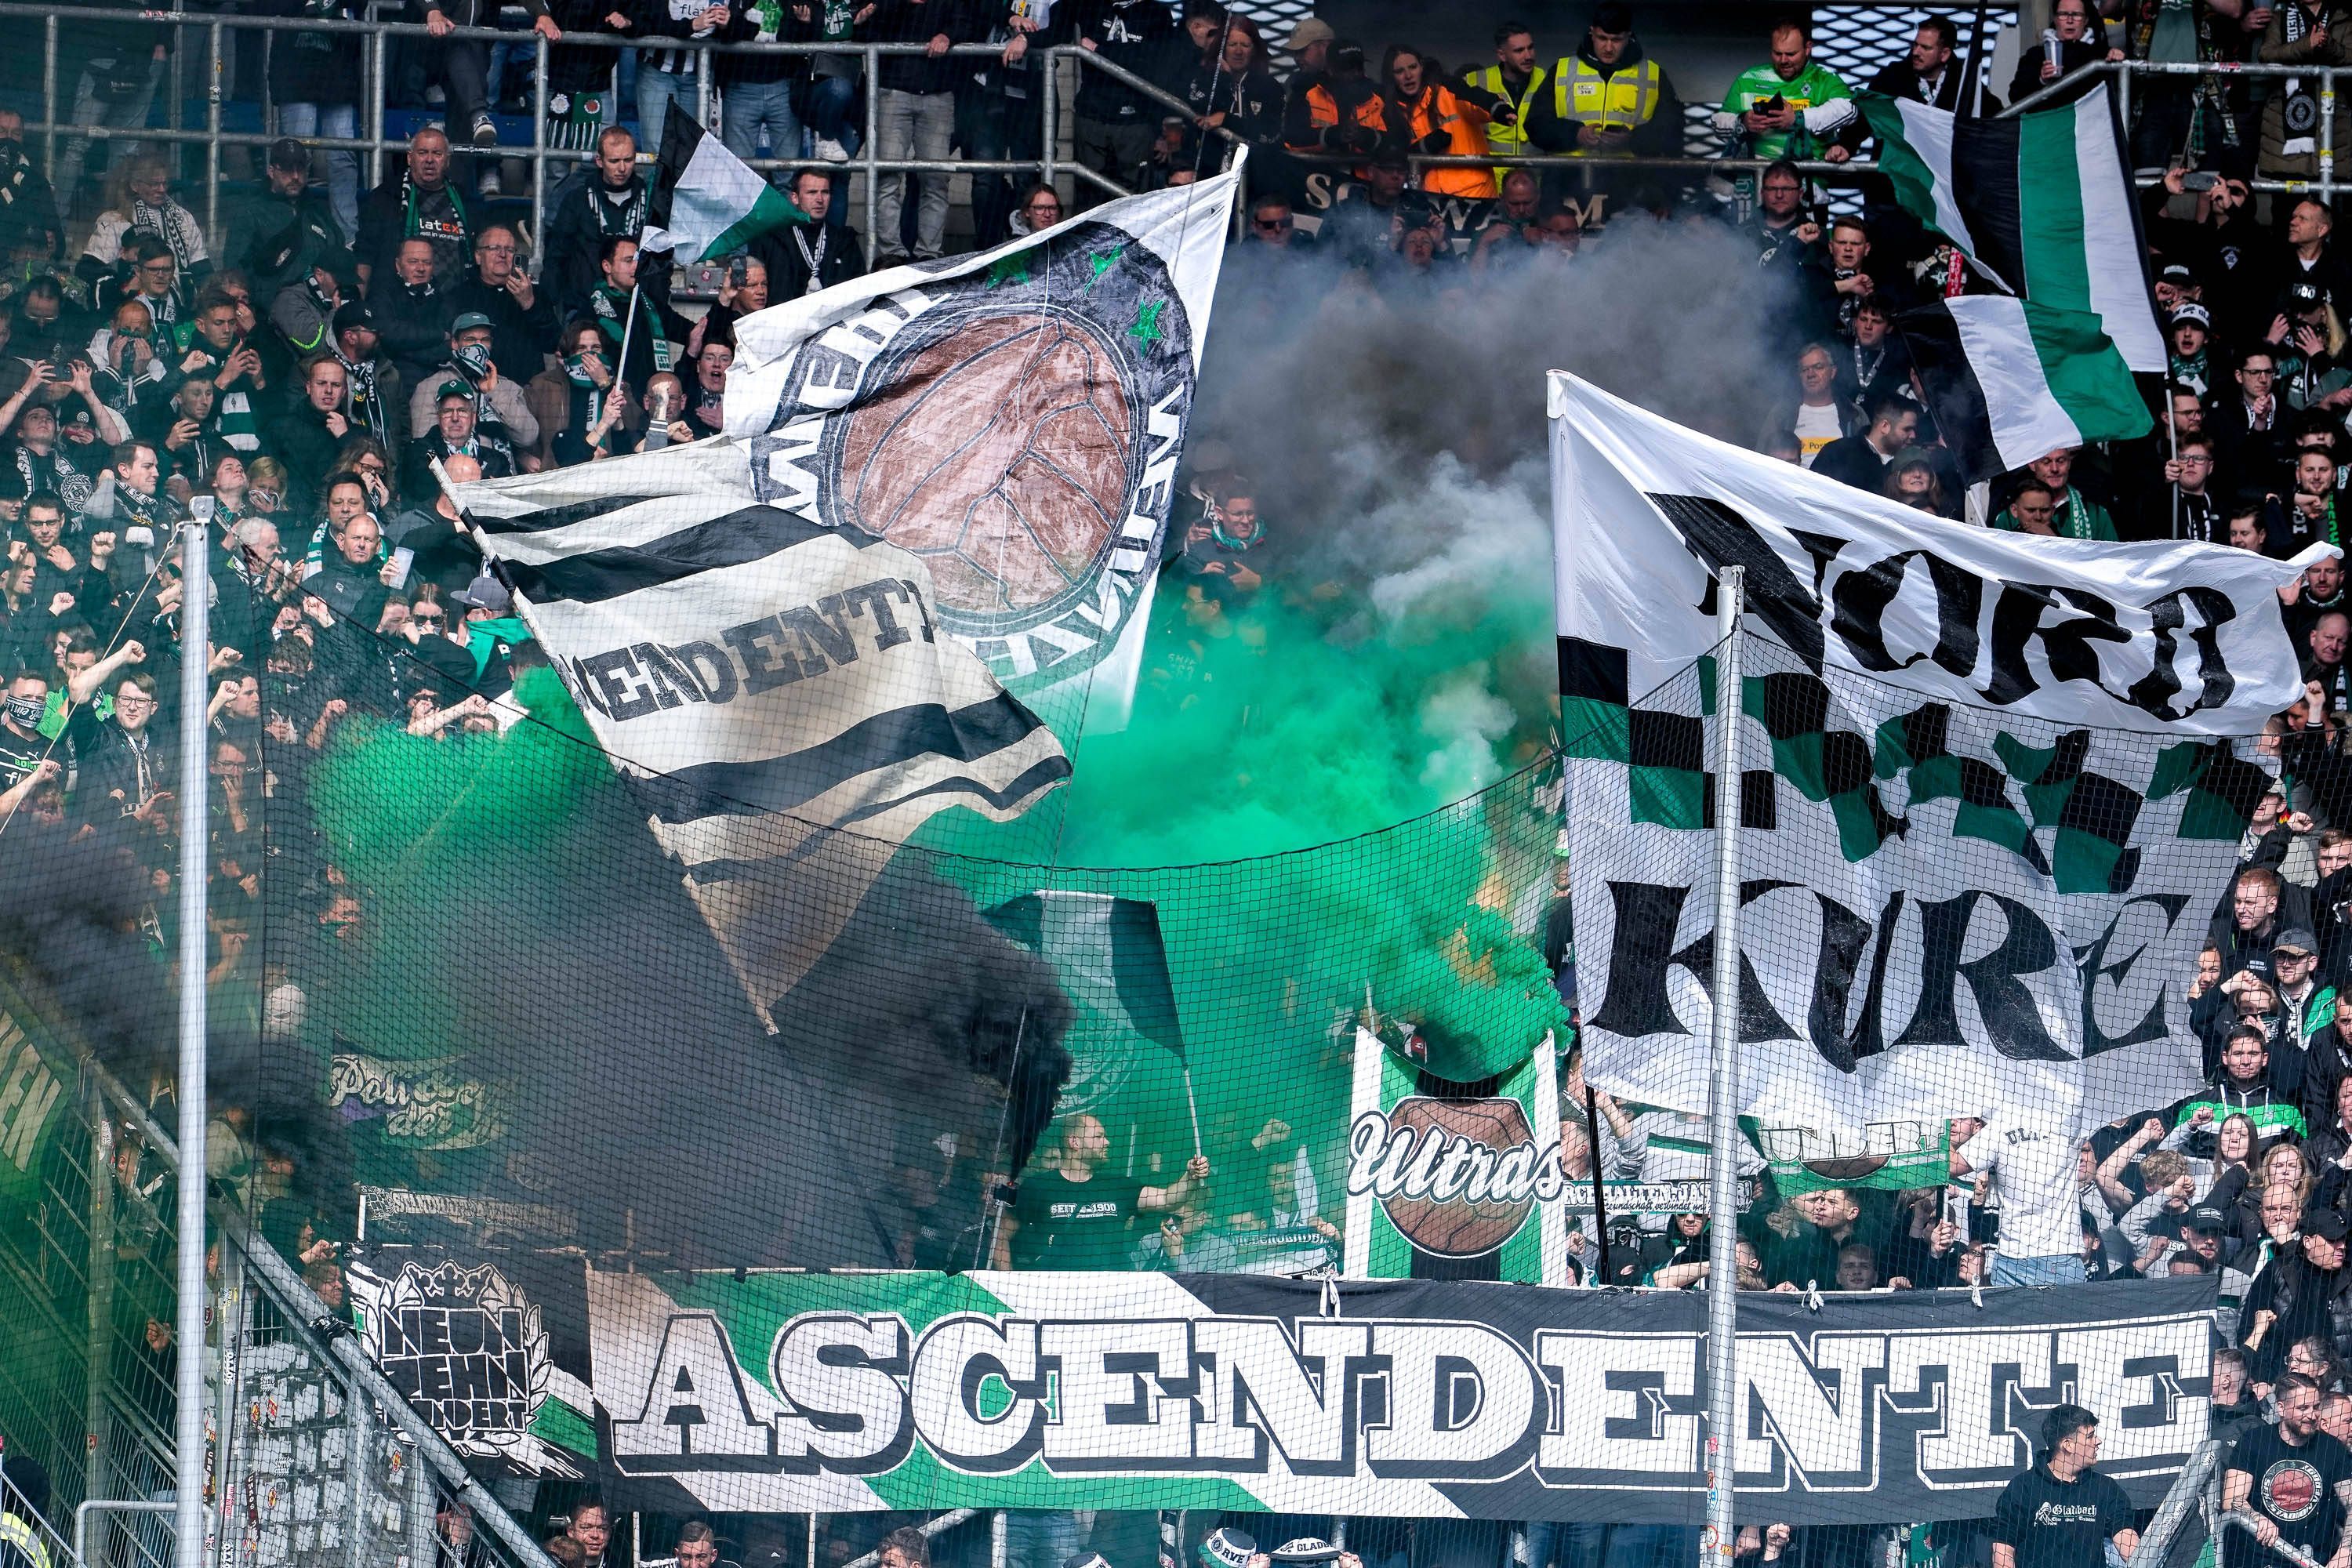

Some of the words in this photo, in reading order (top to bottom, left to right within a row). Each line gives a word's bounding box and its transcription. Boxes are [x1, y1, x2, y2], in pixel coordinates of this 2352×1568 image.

[133, 199, 151, 227] SSIA
[419, 217, 461, 235] latex
[1645, 492, 2236, 721] NORD
[1587, 878, 2192, 1073] KURE
[1347, 1110, 1563, 1205] Ultras
[1051, 1203, 1077, 1214] SEIT
[1092, 1203, 1116, 1214] 1900
[1605, 1200, 1653, 1212] reundschaft
[380, 1305, 525, 1357] NEUN
[224, 1350, 236, 1386] SOTTO
[380, 1349, 531, 1401] ZEHN
[384, 1399, 530, 1433] NDERT
[612, 1309, 2214, 1491] ASCENDENTE
[2053, 1504, 2097, 1517] Gladbach
[1222, 1547, 1243, 1564] RVE
